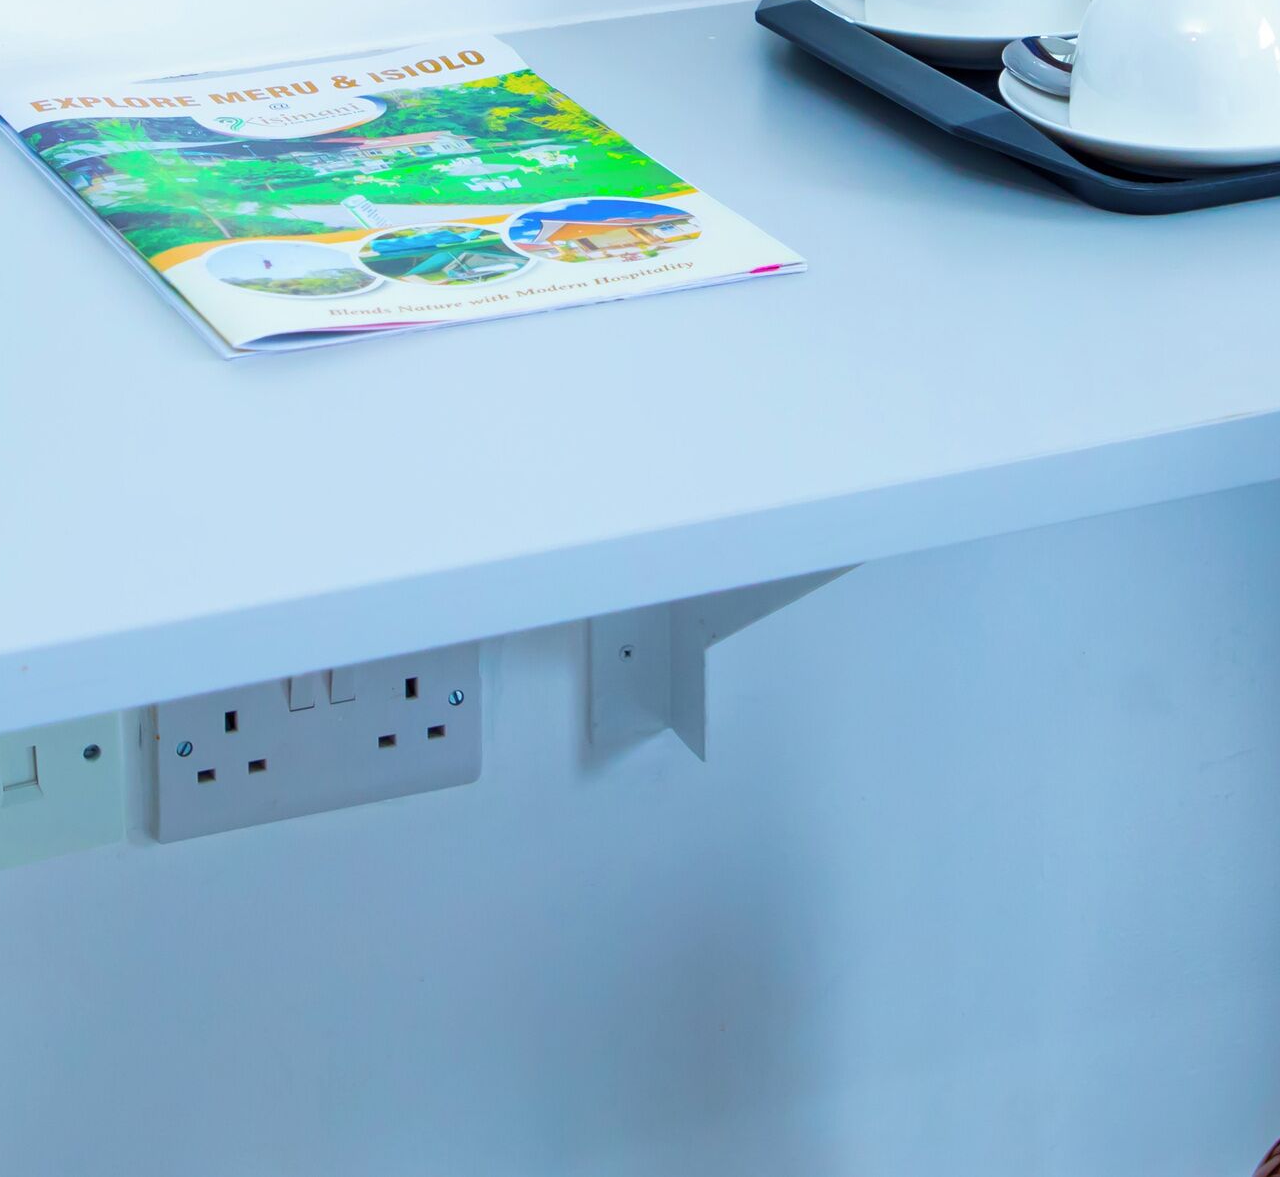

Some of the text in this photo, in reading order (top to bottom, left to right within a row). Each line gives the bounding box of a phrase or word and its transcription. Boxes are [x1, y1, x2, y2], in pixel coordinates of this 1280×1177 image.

[29, 49, 486, 113] EXPLORE MERU & ISIOLO
[329, 260, 695, 316] Blends Nature with Modern Hospitality
